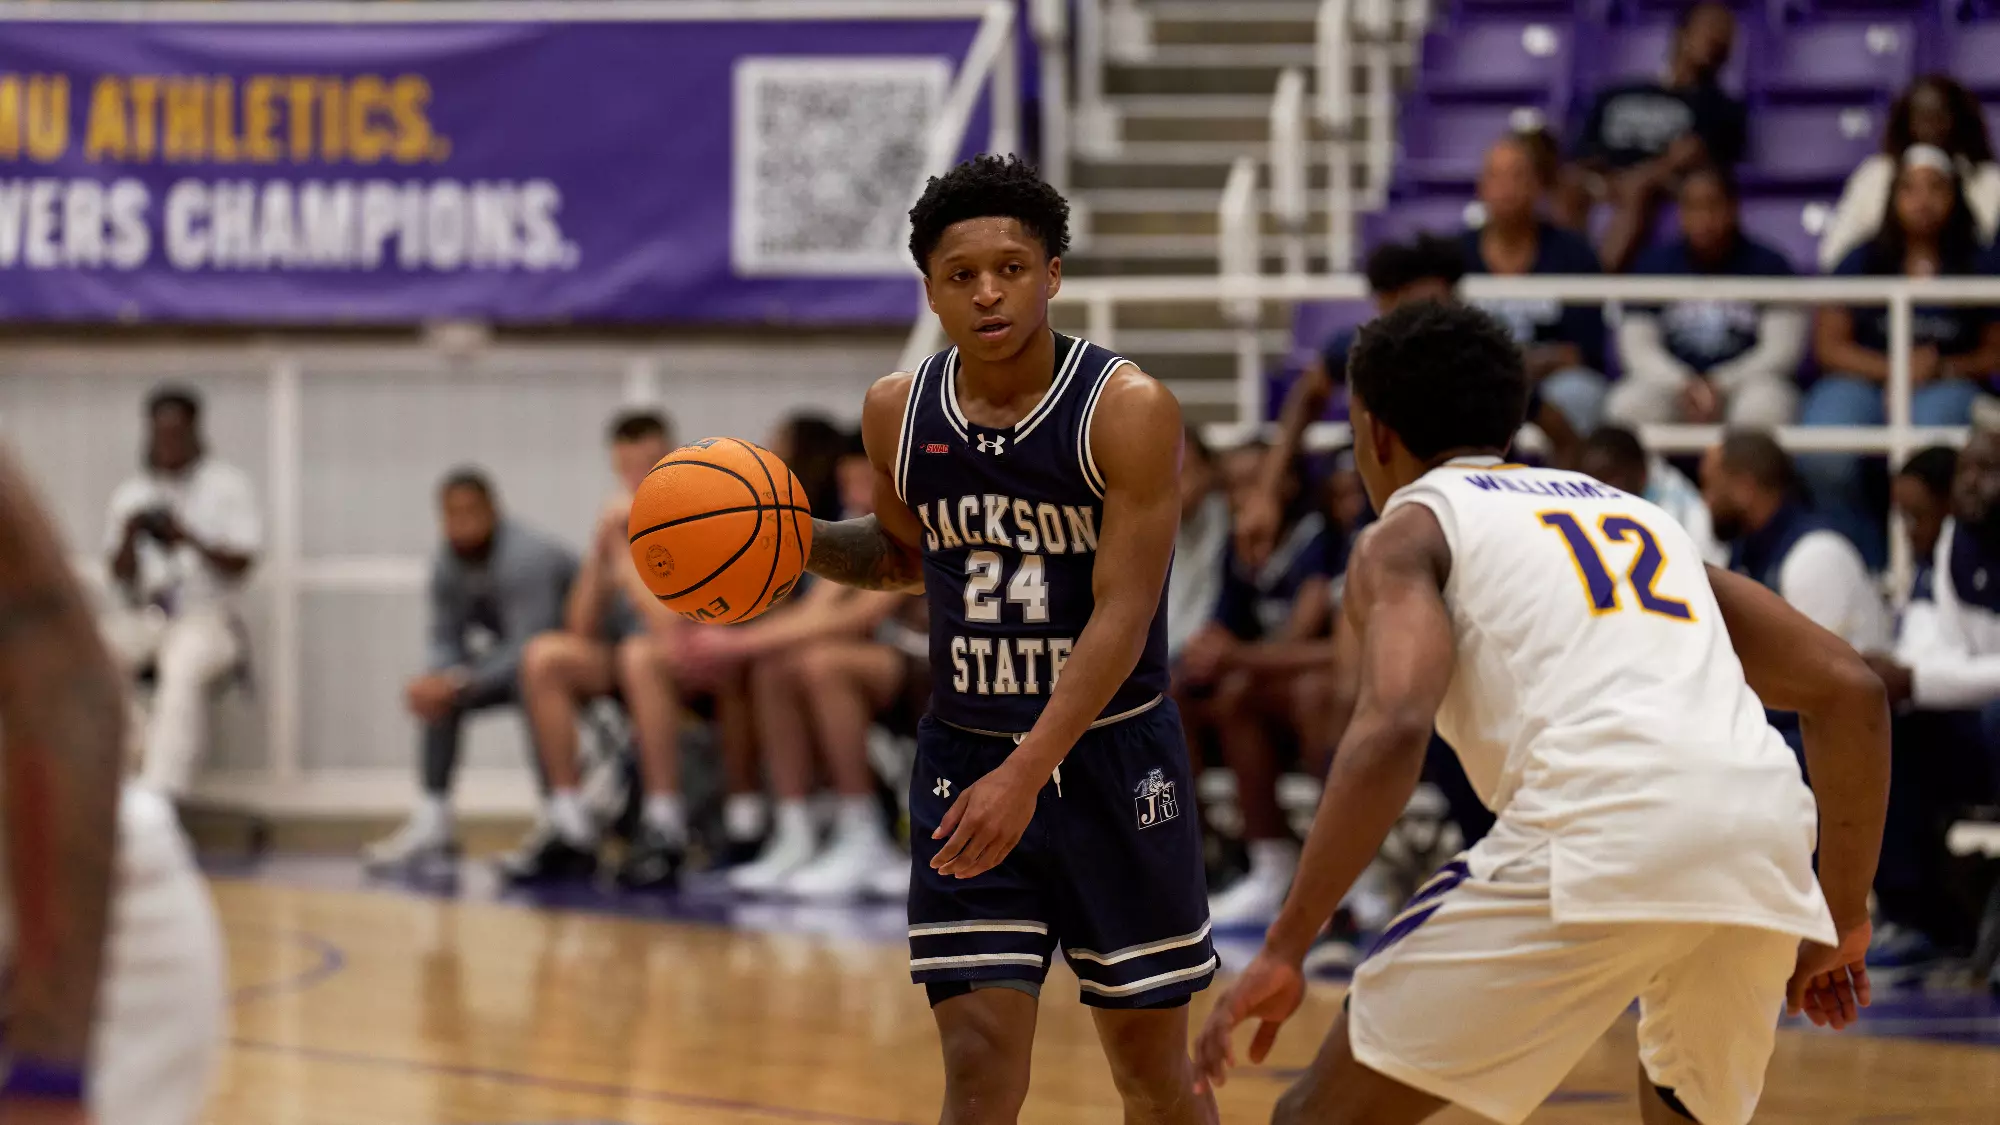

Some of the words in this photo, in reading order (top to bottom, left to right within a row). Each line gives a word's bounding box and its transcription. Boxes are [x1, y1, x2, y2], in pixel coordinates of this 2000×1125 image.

[86, 75, 452, 163] ATHLETICS.
[165, 178, 580, 270] CHAMPIONS.
[917, 494, 1097, 554] JACKSON
[1535, 509, 1698, 617] 12
[964, 550, 1050, 623] 24
